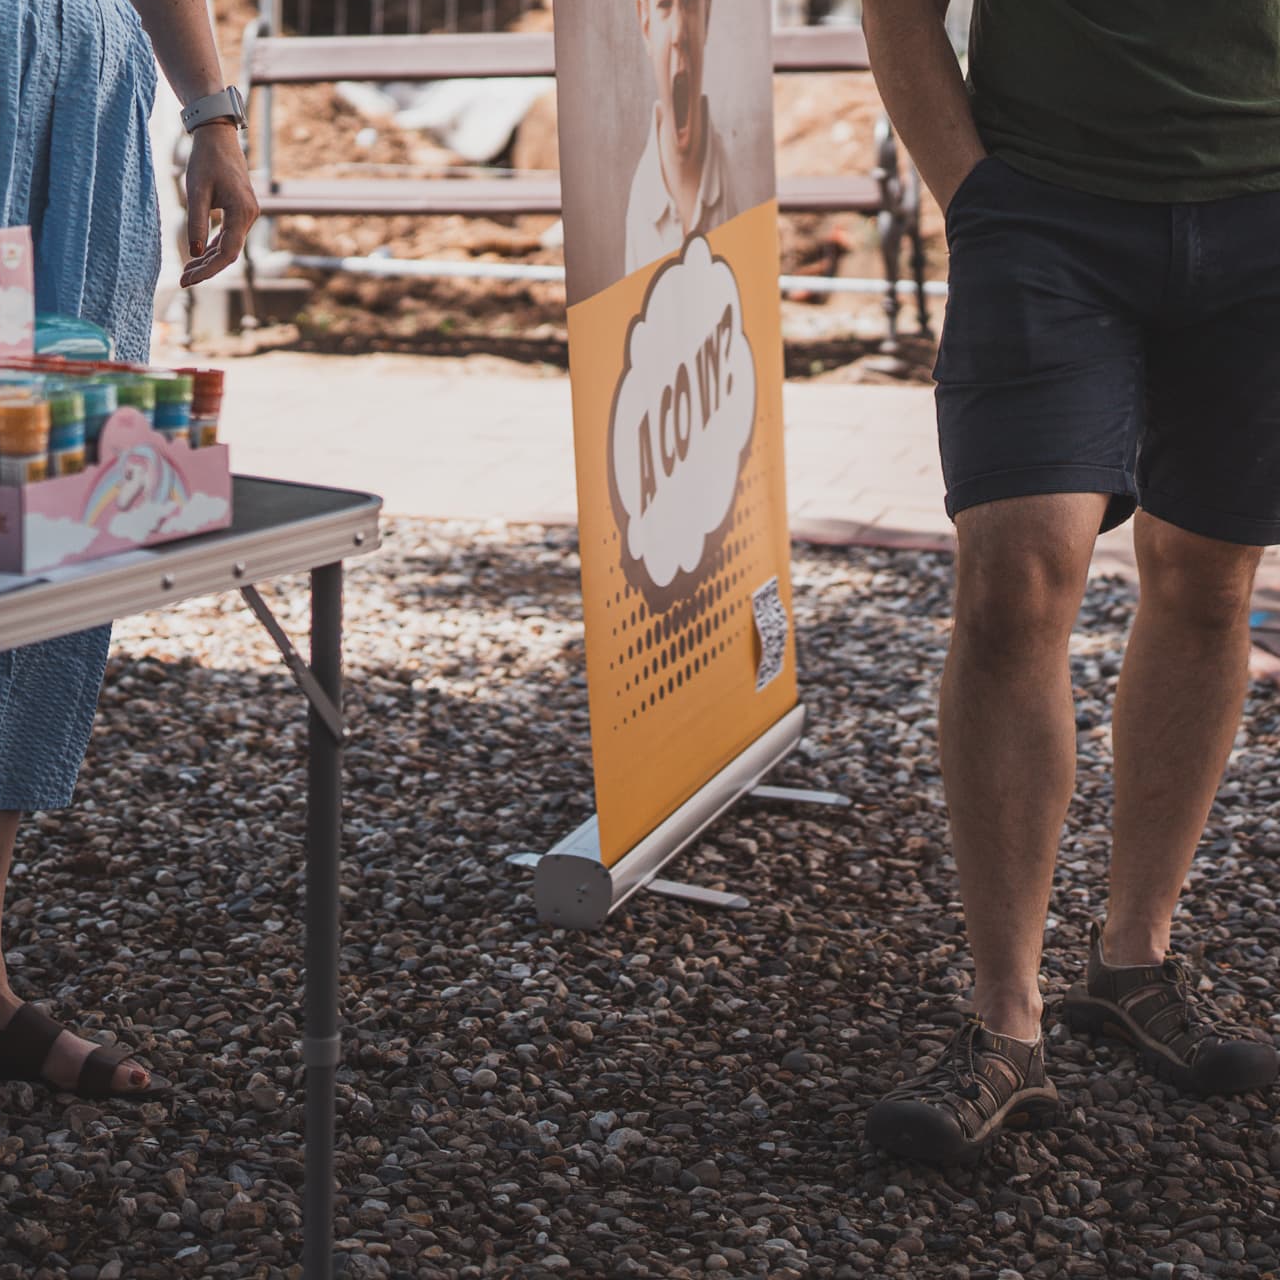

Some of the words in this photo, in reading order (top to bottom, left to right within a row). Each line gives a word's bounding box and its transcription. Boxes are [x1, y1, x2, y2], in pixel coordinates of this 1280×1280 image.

[638, 409, 658, 518] A
[659, 362, 691, 478] CO
[695, 303, 733, 432] VY?
